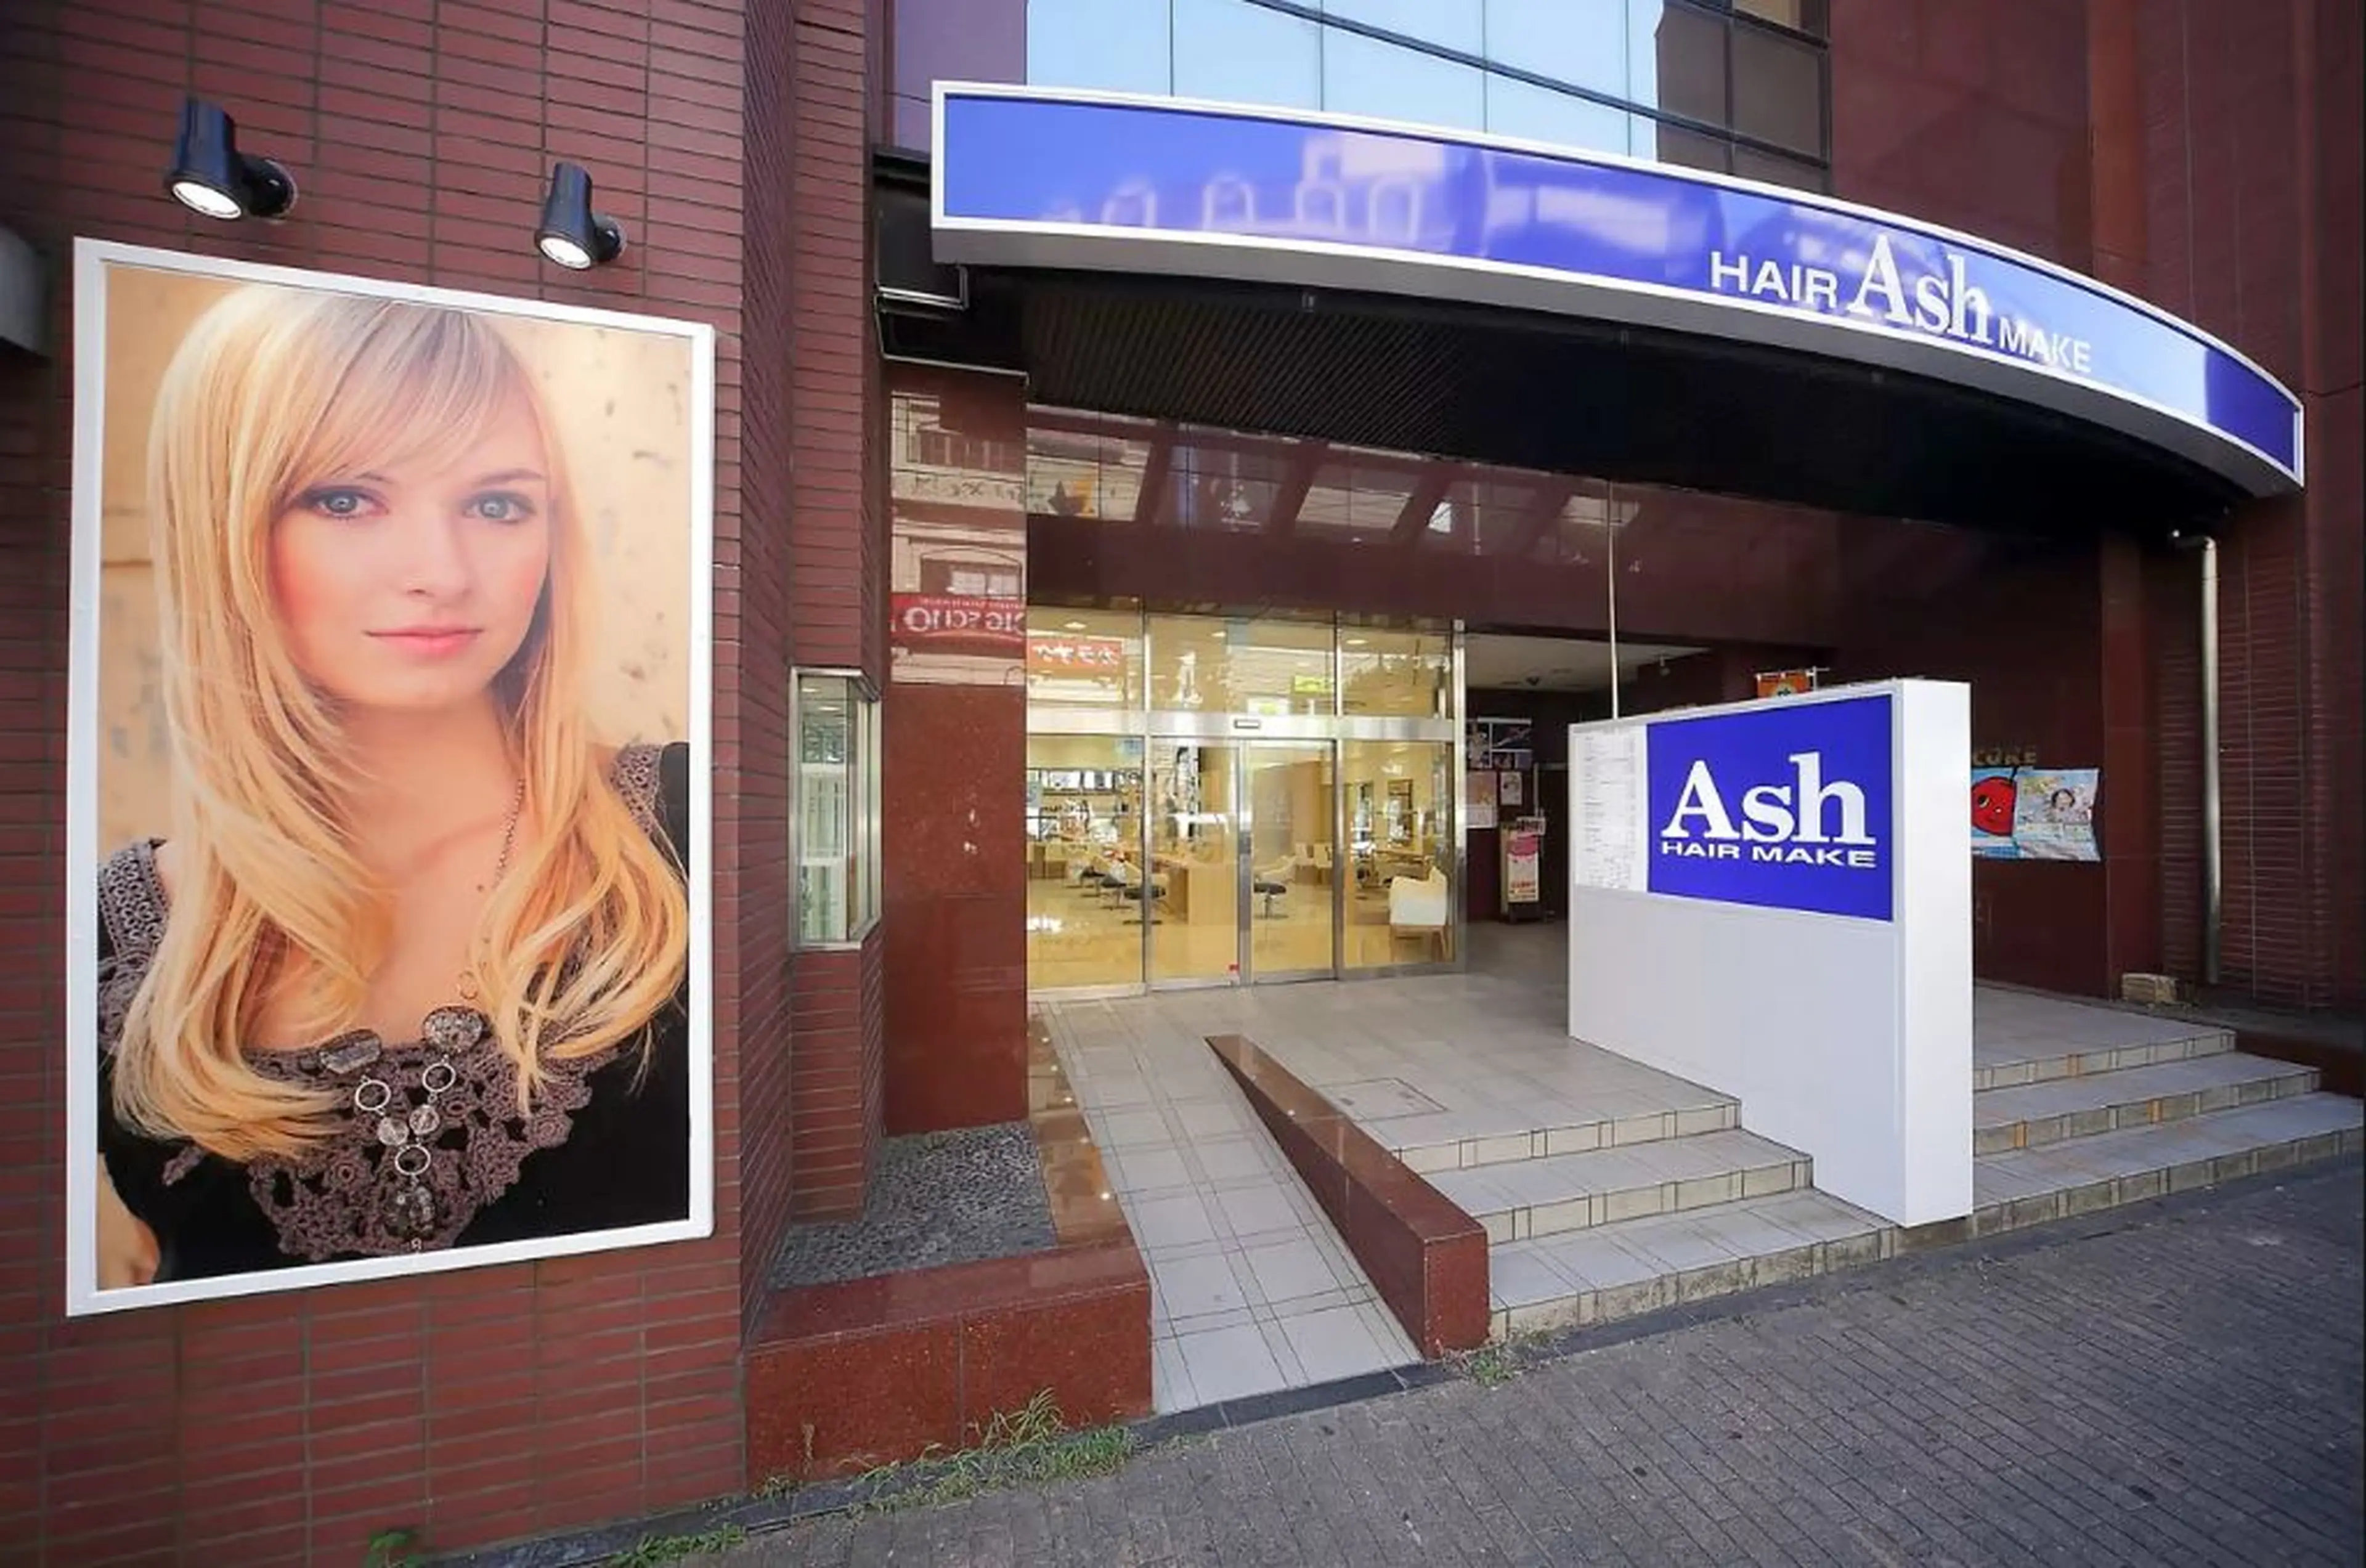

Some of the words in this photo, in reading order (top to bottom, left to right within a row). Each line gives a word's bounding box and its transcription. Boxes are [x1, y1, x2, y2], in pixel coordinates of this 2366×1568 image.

[1710, 251, 1839, 307] HAIR
[1848, 234, 1991, 345] Ash
[1999, 315, 2092, 372] MAKE
[1661, 751, 1877, 845] Ash
[1662, 842, 1740, 859] HAIR
[1752, 846, 1877, 868] MAKE
